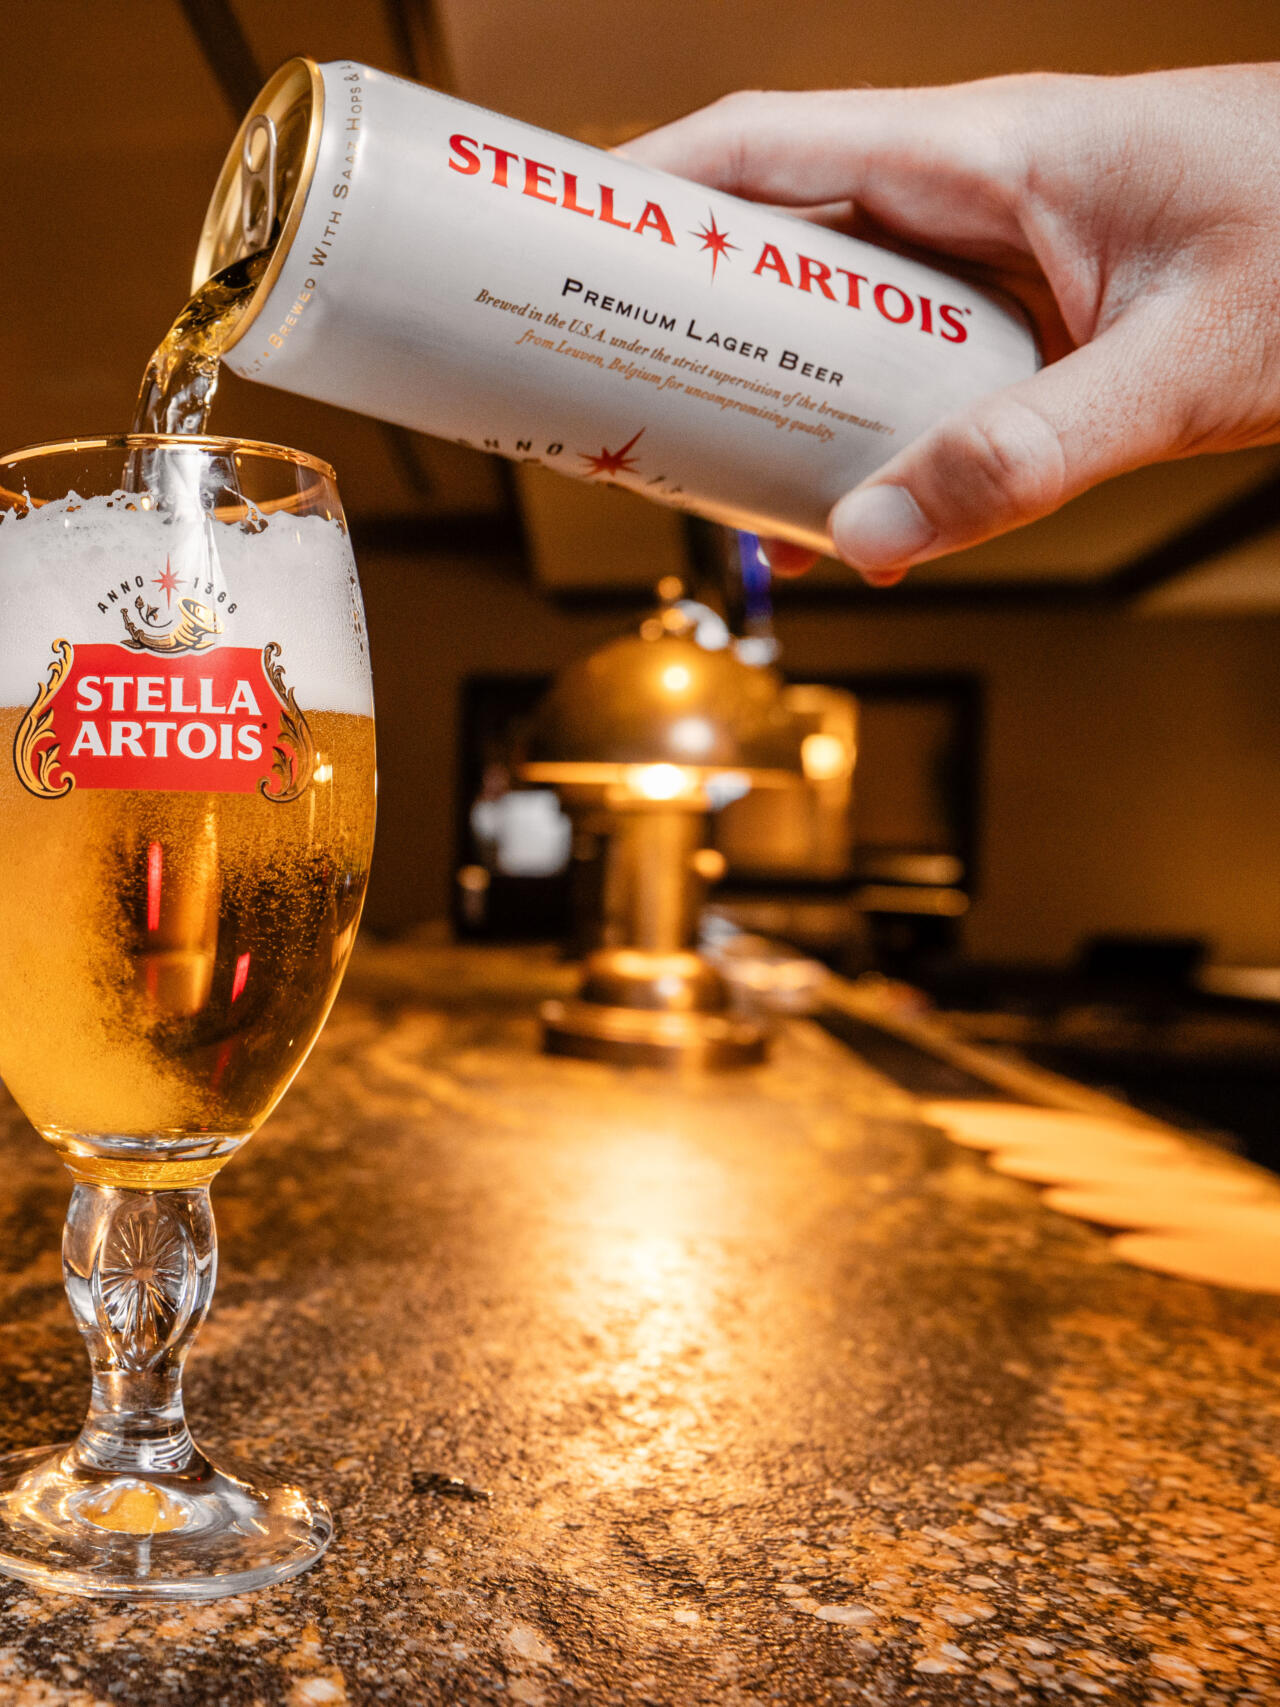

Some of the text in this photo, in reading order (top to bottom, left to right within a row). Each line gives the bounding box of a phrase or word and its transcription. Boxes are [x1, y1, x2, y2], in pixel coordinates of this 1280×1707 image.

[269, 277, 316, 349] BREWED
[309, 210, 342, 267] WITH
[345, 86, 362, 131] HOPS
[448, 133, 969, 345] STELLA ARTOIS
[476, 288, 896, 436] Brewed in the U.S.A. under the strict supervision of the brewmasters
[515, 328, 555, 349] from
[555, 340, 605, 369] Leuven,
[607, 357, 662, 384] Belgium
[657, 375, 684, 390] for
[684, 384, 790, 430] uncompromising
[561, 277, 844, 387] PREMIUM LAGER BEER
[96, 575, 238, 615] ANNO 1366
[70, 721, 263, 762] ARTOIS
[75, 676, 262, 716] STELLA
